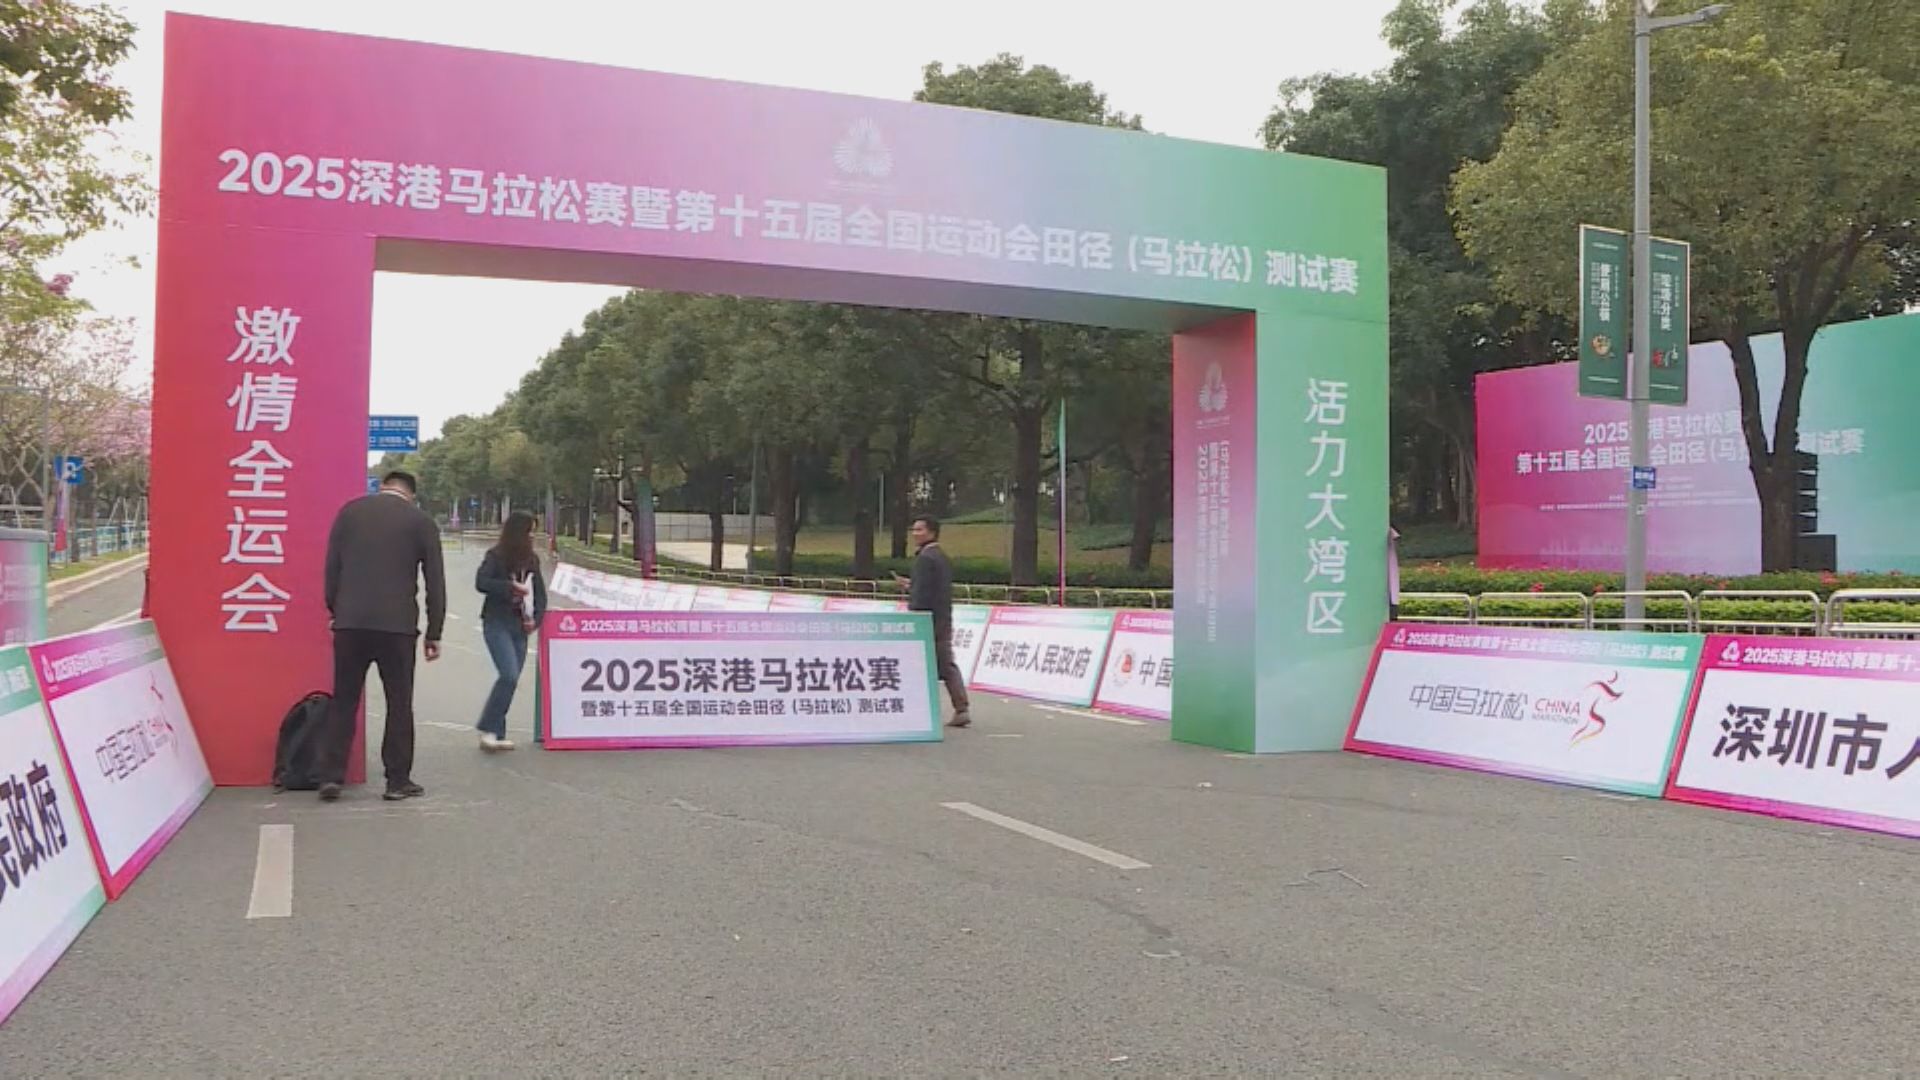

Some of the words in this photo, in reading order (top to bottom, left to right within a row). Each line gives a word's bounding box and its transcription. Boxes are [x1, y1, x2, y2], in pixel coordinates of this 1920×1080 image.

[1584, 411, 1742, 445] 2025港马拉松赛
[220, 305, 302, 634] 激情全运会
[1303, 377, 1350, 634] 活力大湾区
[580, 657, 903, 695] 2025深港马拉松赛
[984, 639, 1094, 679] 深圳市人民政府
[1408, 683, 1529, 721] 中国马拉松
[1534, 697, 1582, 717] CHINA
